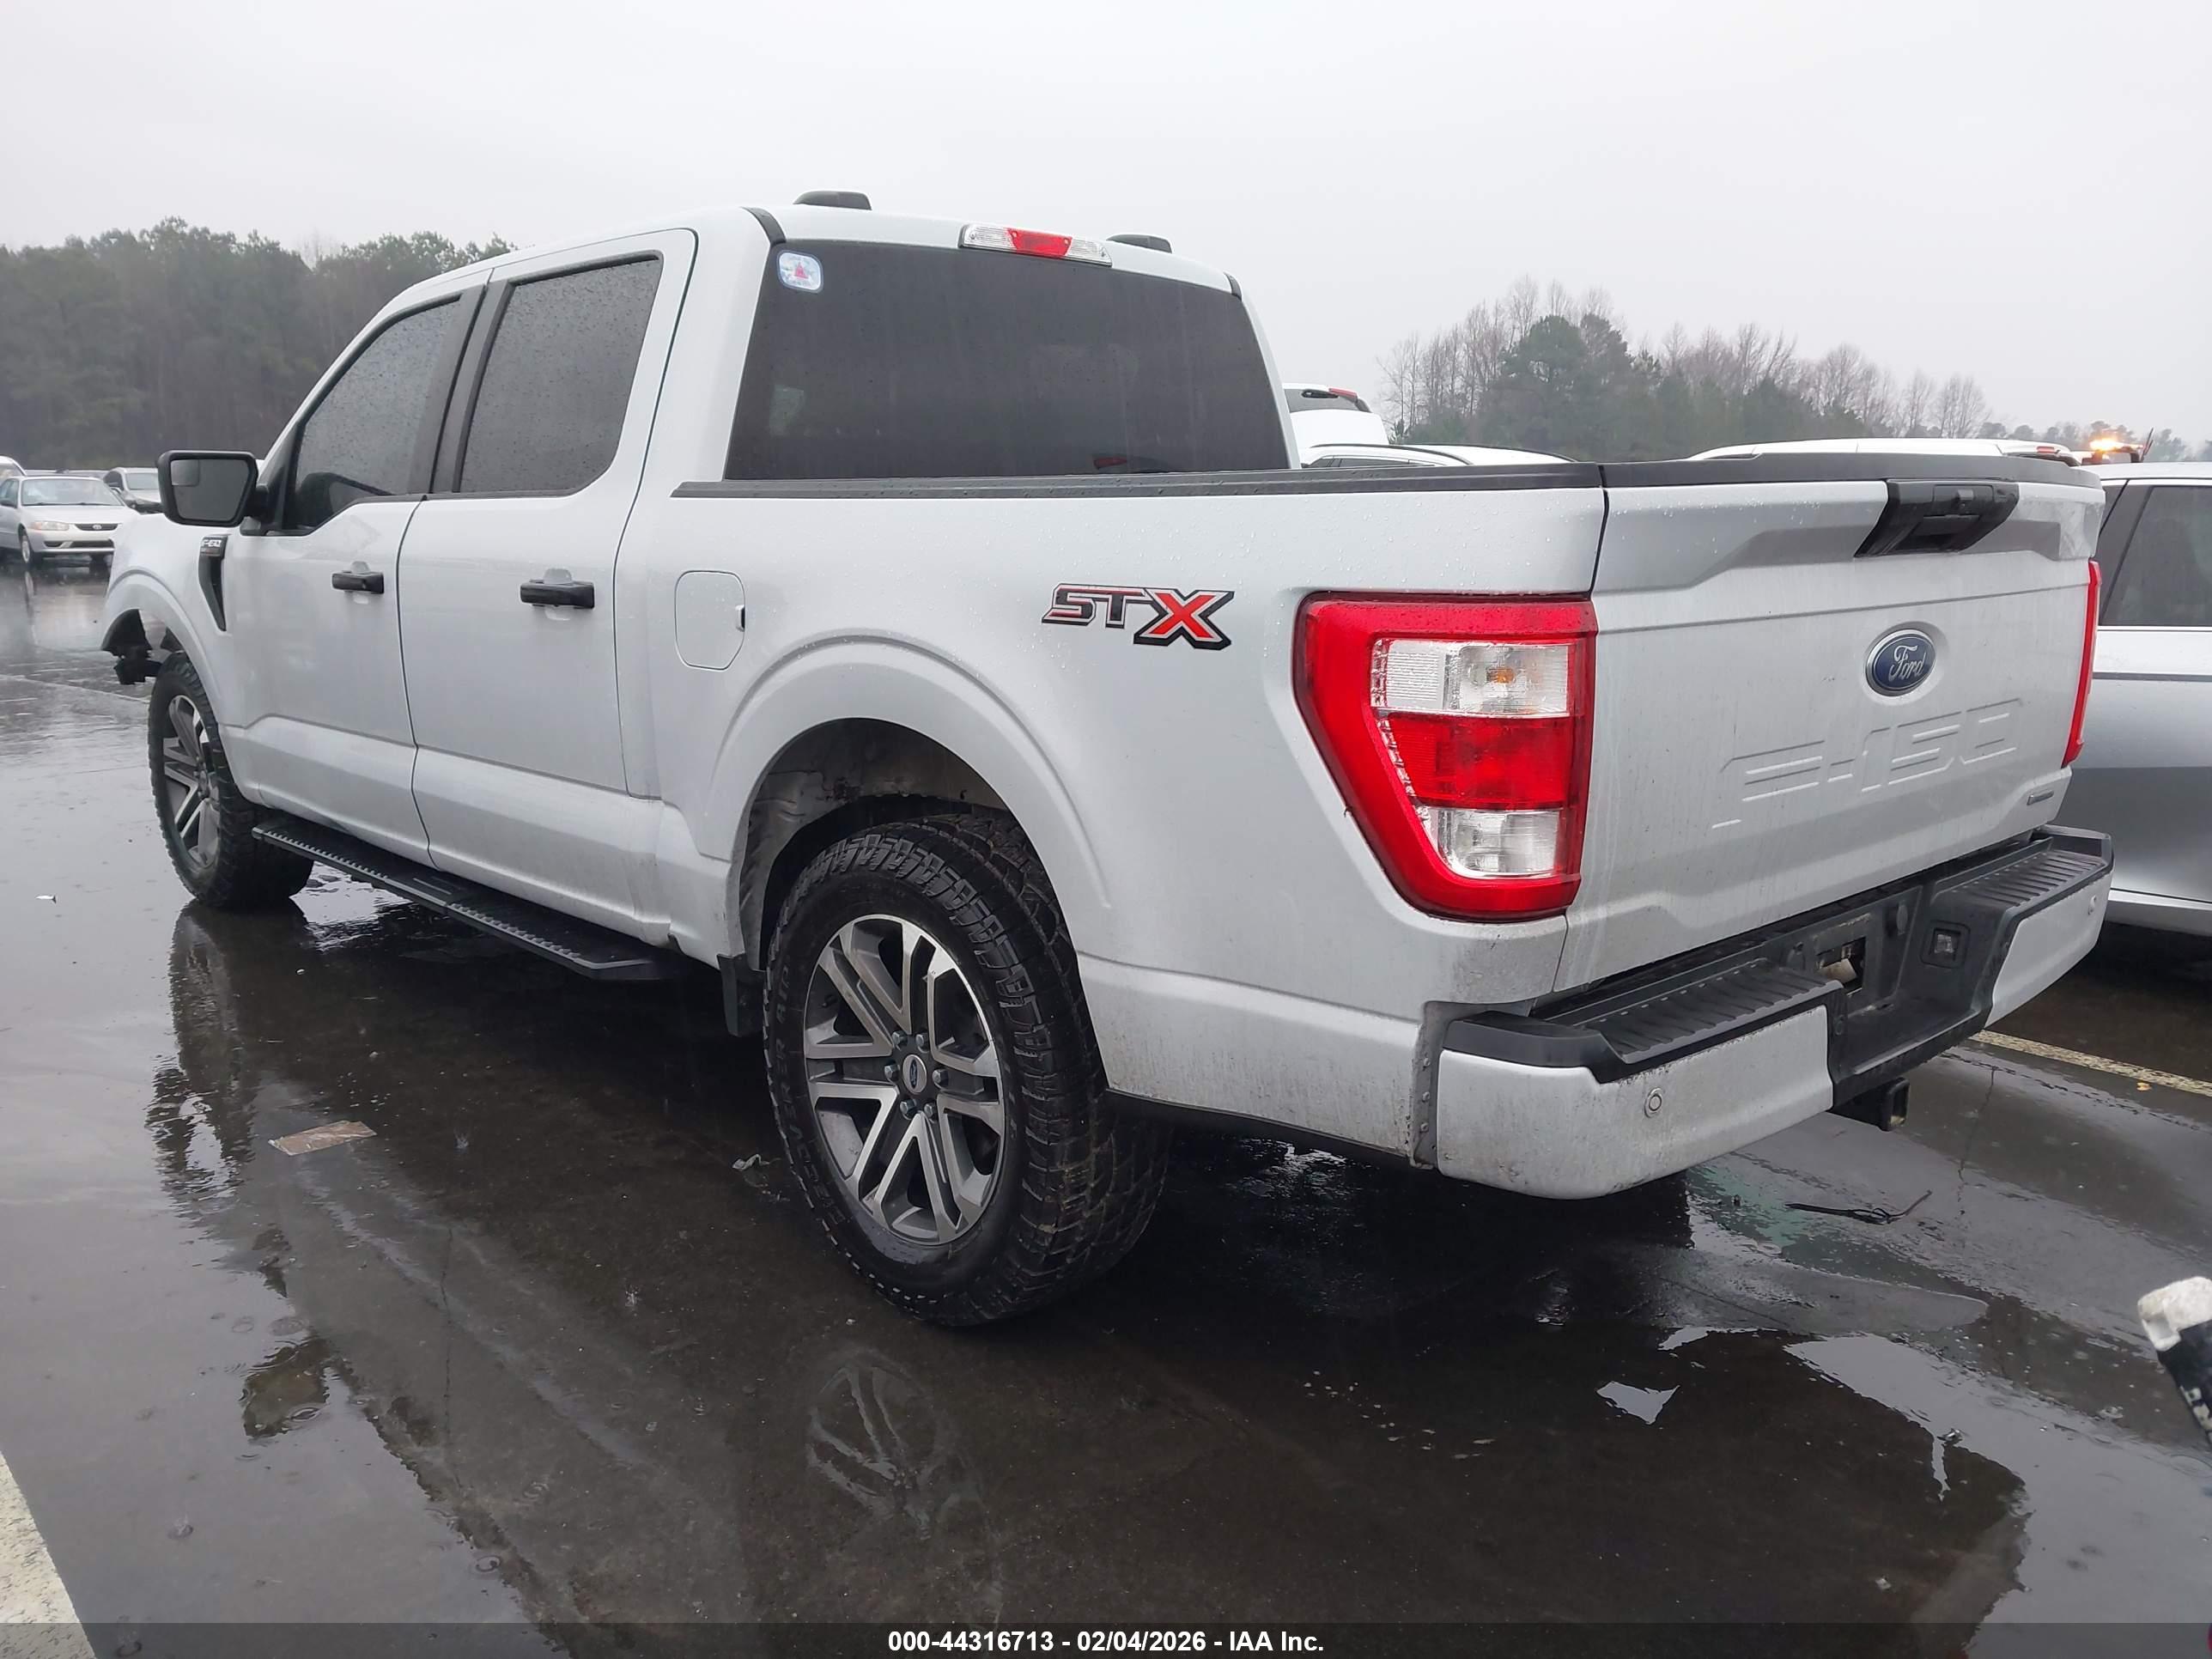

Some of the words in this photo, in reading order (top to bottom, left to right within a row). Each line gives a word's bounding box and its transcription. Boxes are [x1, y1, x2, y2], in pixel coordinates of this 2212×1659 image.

[1042, 583, 1235, 651] STX
[1888, 645, 1926, 682] Ford
[1712, 697, 2023, 829] F-150
